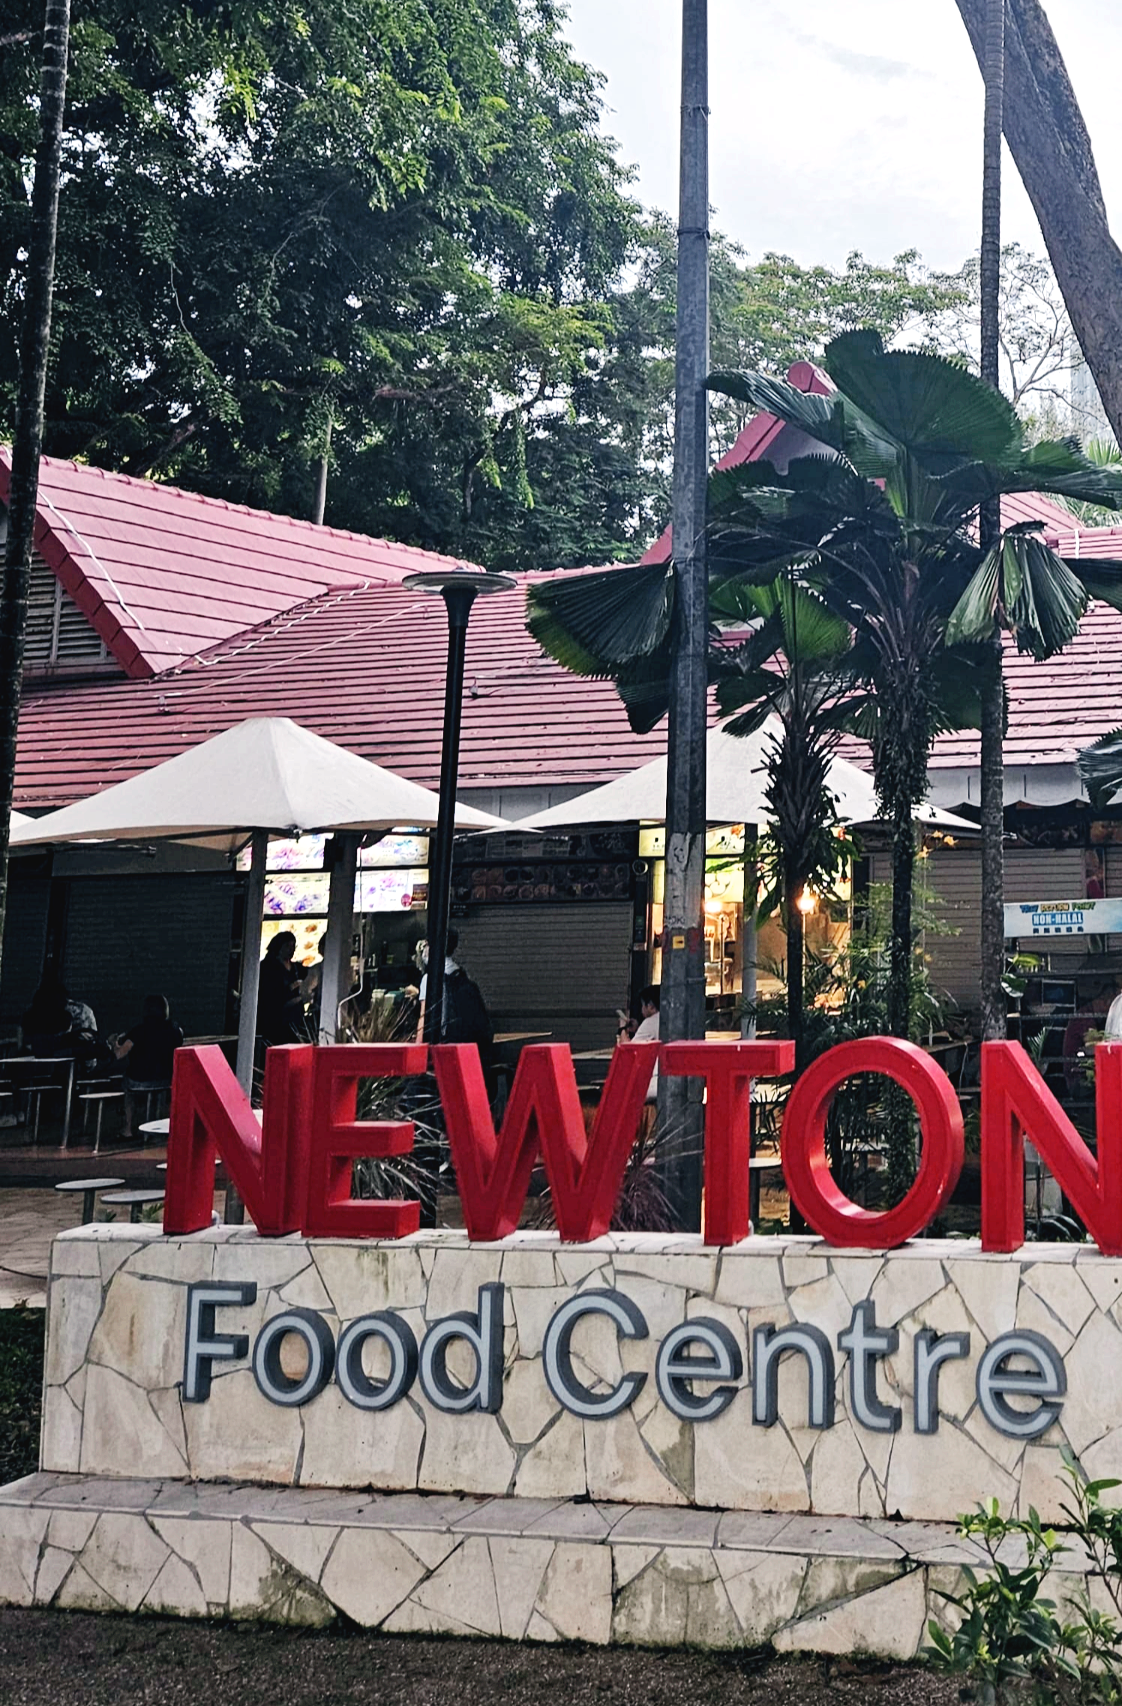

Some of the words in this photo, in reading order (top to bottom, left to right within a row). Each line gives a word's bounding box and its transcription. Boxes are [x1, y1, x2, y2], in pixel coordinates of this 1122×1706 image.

[1033, 912, 1083, 925] NON-HALAL
[181, 1281, 504, 1415] Food
[543, 1287, 1067, 1439] Centre
